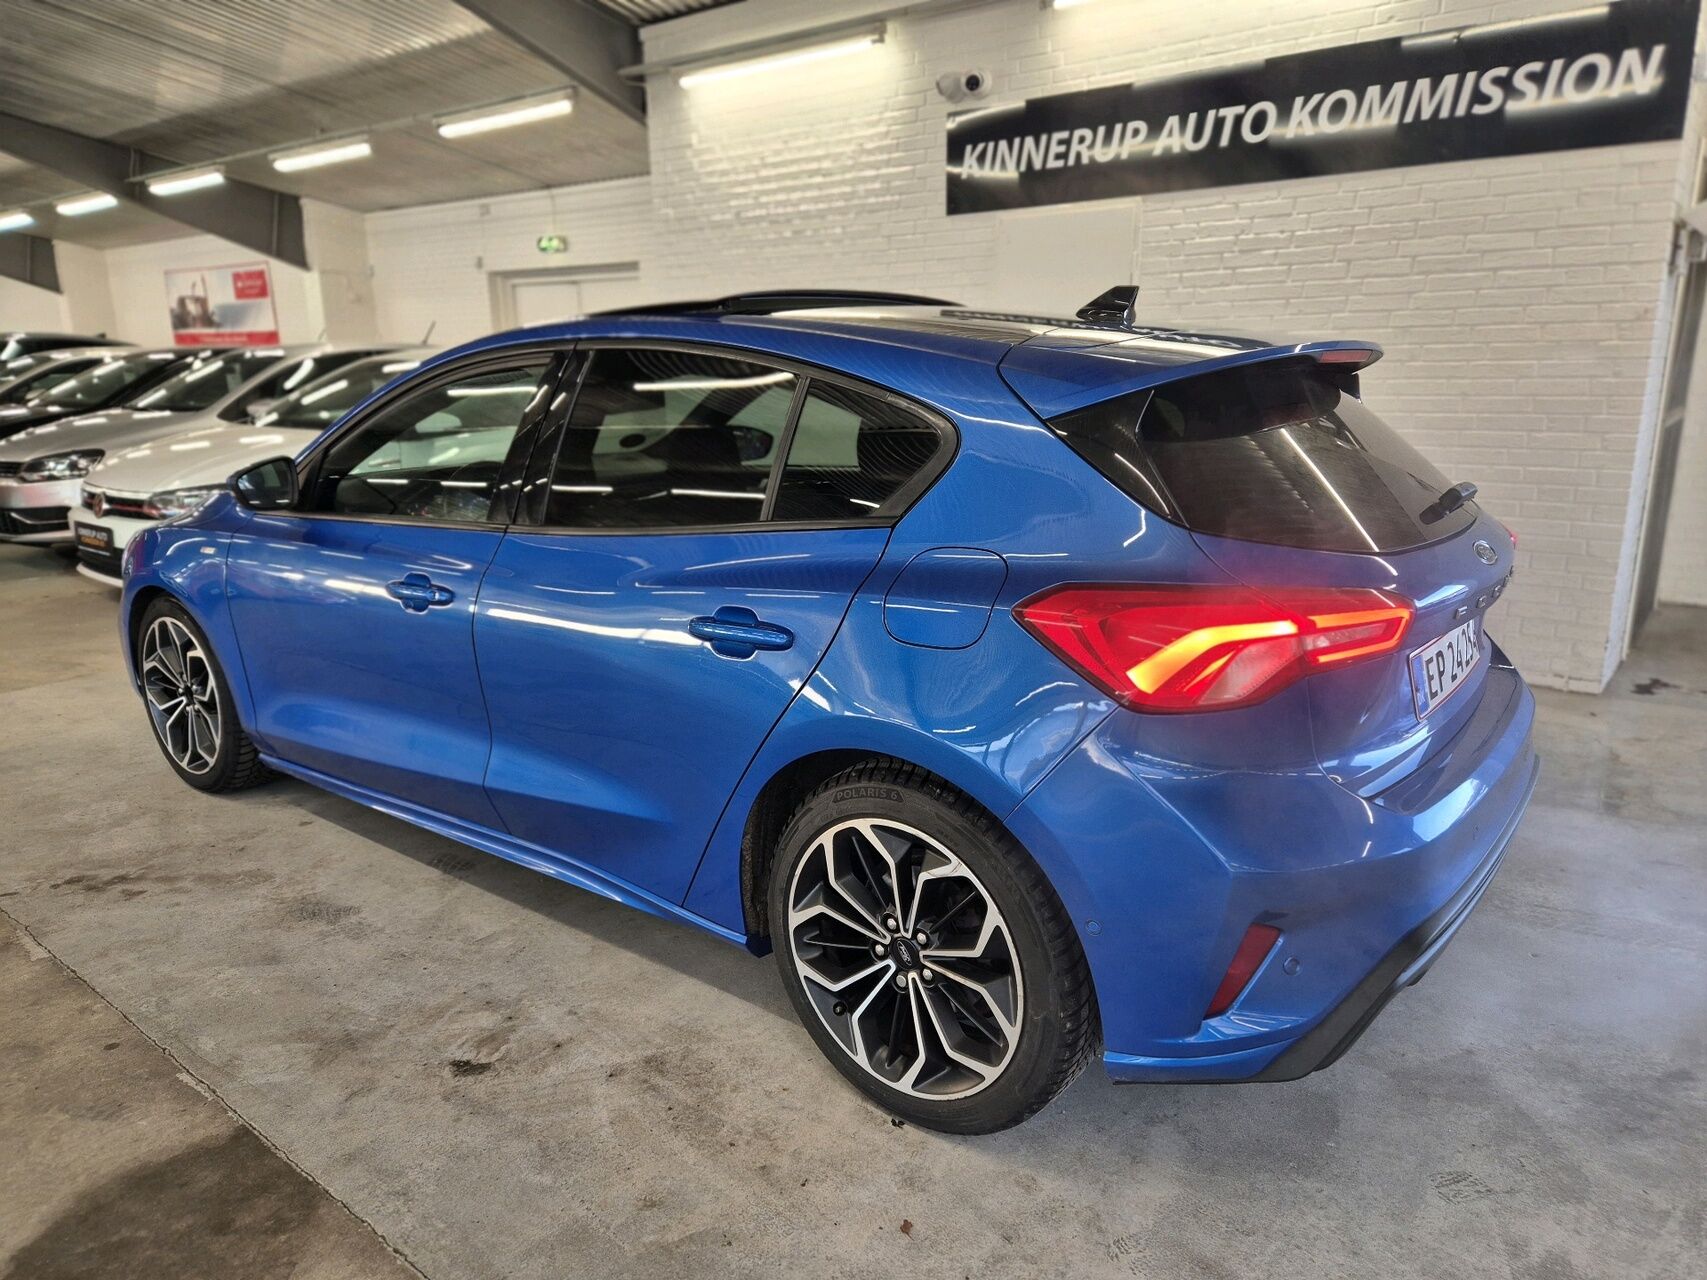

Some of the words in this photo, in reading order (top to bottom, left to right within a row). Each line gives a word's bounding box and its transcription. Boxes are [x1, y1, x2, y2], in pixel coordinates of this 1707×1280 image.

[961, 121, 1147, 179] KINNERUP
[1152, 101, 1277, 157] AUTO
[1285, 43, 1666, 139] KOMMISSION
[1425, 649, 1445, 701] EP
[837, 788, 885, 801] POLARIS
[890, 790, 898, 799] 6
